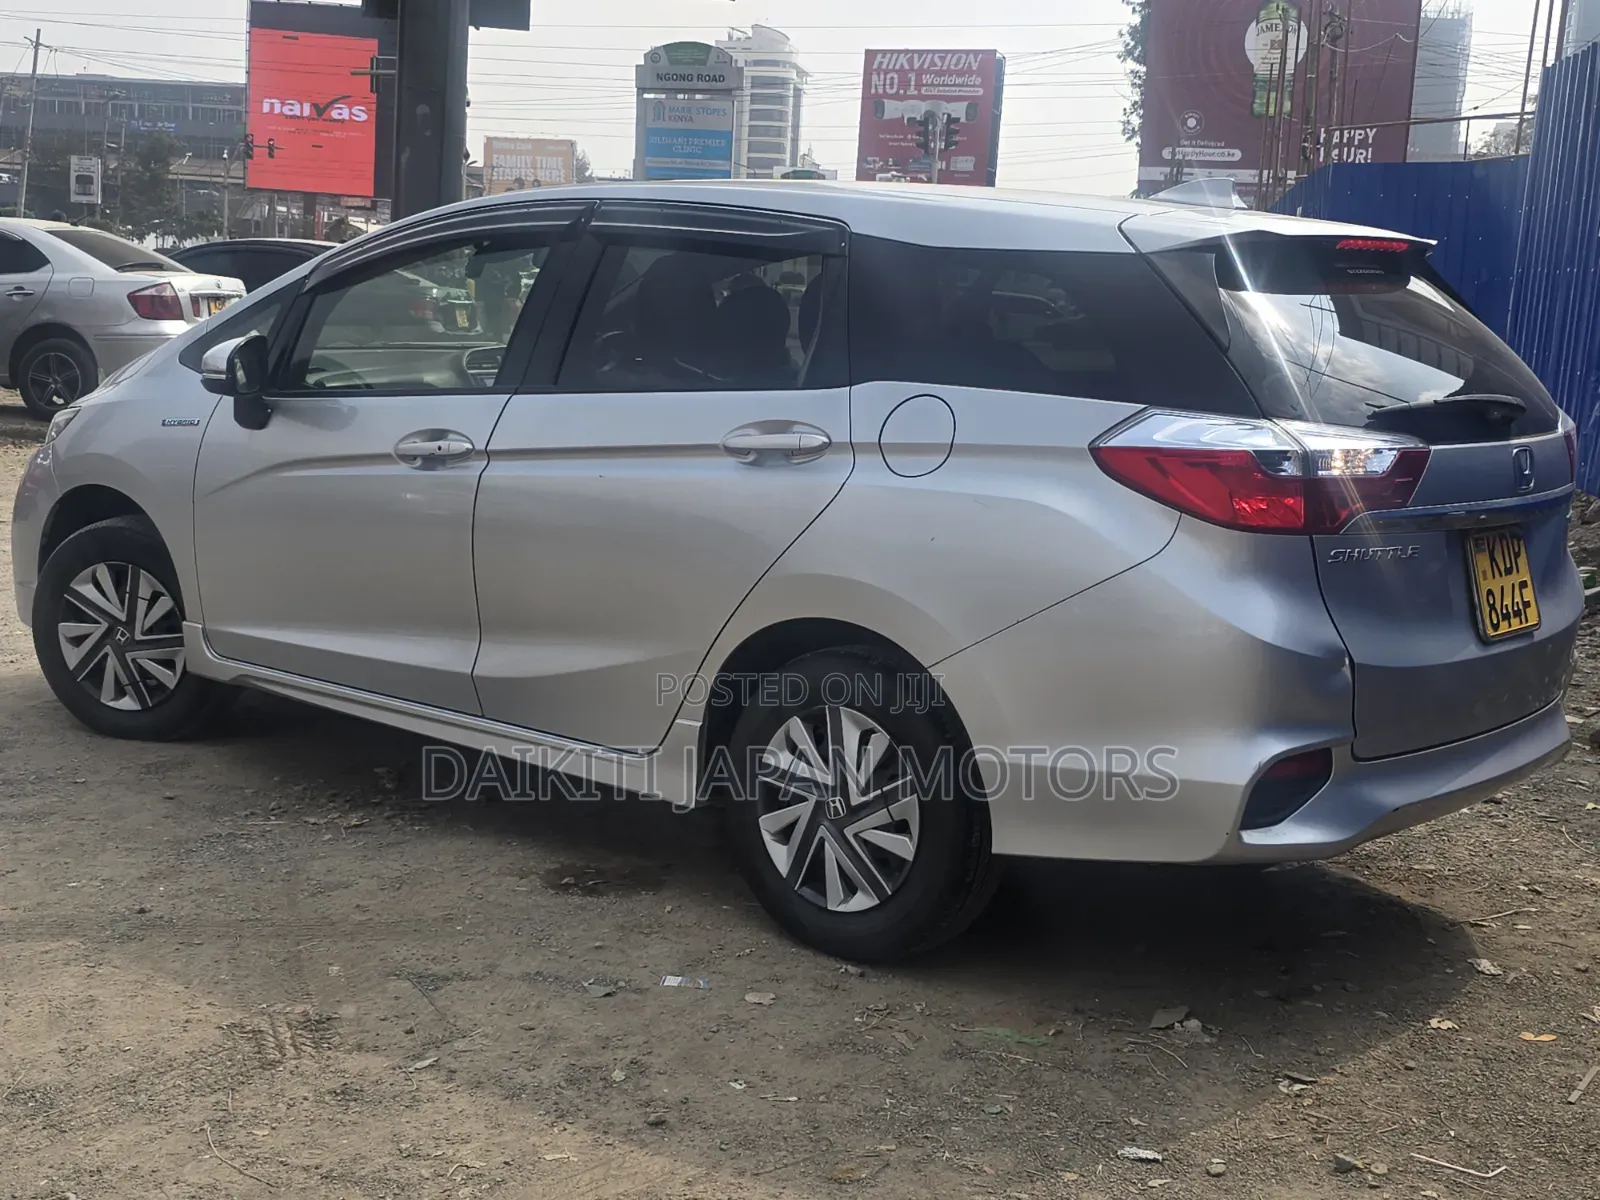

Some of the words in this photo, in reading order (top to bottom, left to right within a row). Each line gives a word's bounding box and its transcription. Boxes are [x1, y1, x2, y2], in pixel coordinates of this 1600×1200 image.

[1256, 22, 1298, 37] JAMEON
[873, 53, 982, 70] HIKVISION
[656, 72, 694, 82] NGONG
[696, 73, 726, 83] ROAD
[871, 72, 917, 95] NO.1
[921, 74, 982, 85] Worldwide
[262, 95, 369, 122] naivas
[668, 105, 693, 115] MARIE
[695, 107, 727, 117] STOPES
[668, 114, 694, 124] KENYA
[672, 145, 703, 154] CLINIC
[1167, 149, 1236, 159] HappyHour.co.ke
[492, 154, 532, 168] FAMILY
[535, 155, 565, 171] TIME
[491, 168, 534, 181] STARTS
[1327, 545, 1421, 563] SHUTTLE
[1486, 580, 1532, 632] 844F
